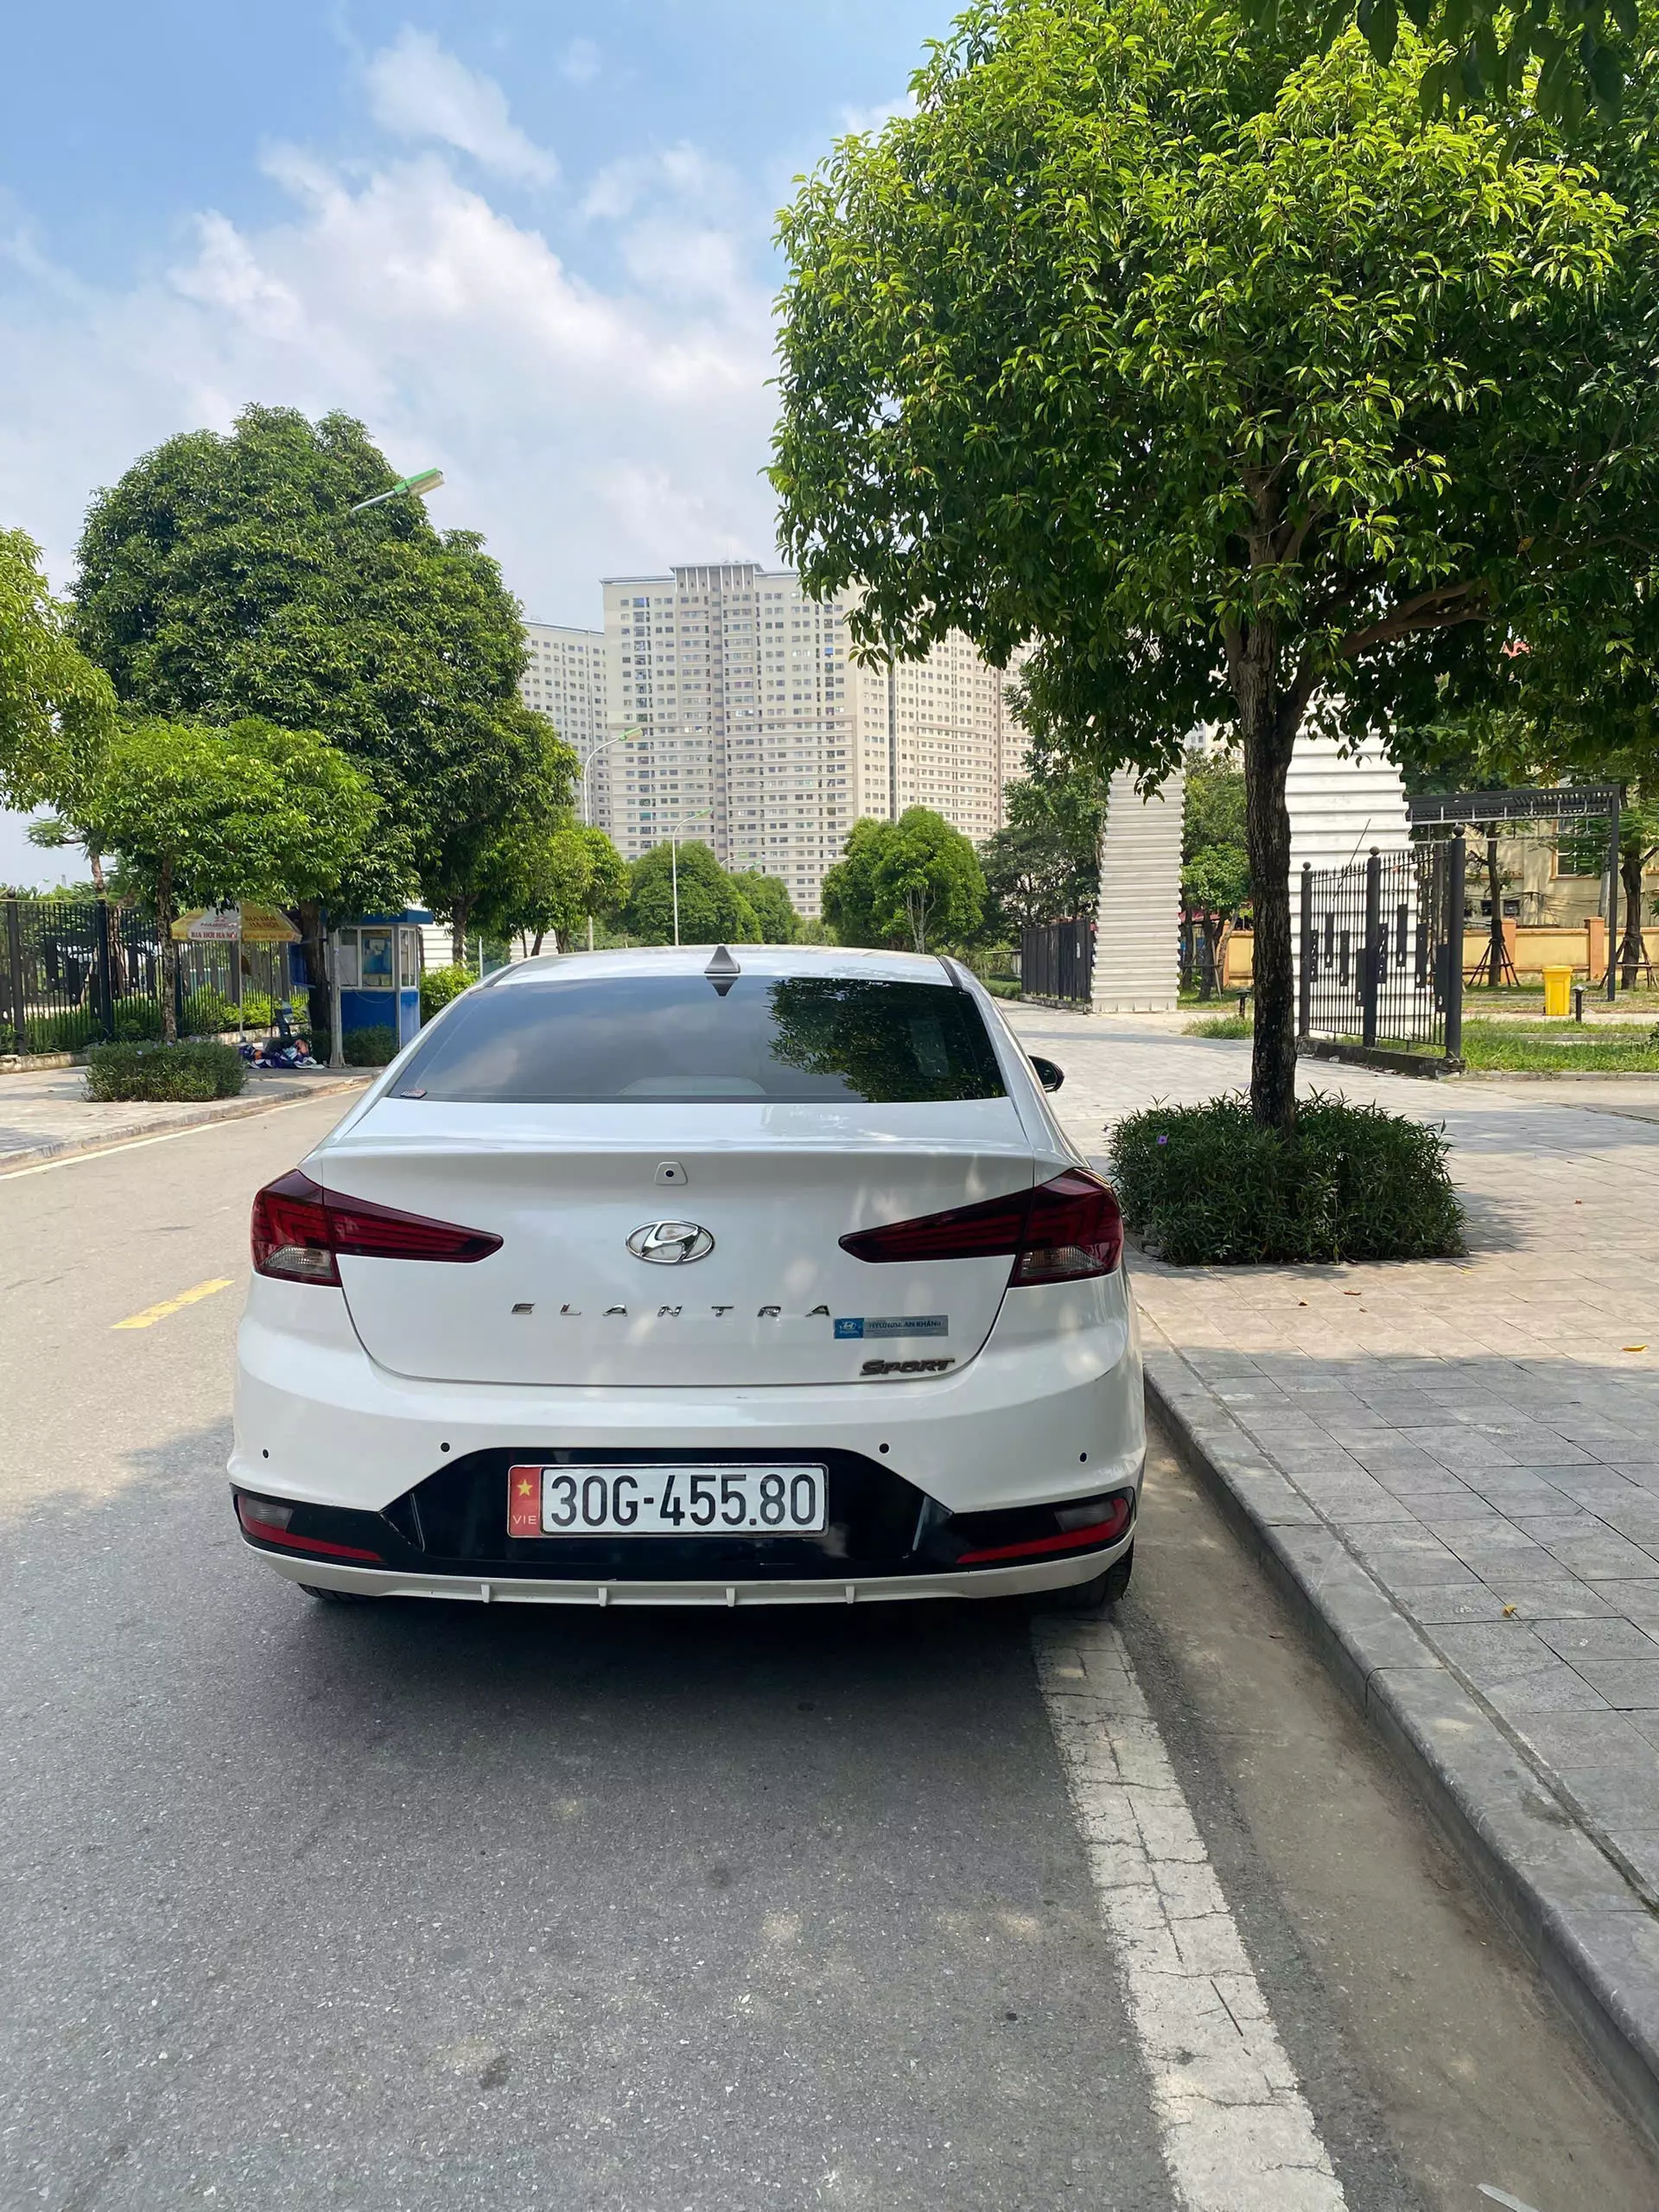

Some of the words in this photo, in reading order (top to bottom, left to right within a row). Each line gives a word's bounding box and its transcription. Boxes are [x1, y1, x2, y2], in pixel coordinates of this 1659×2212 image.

[512, 1303, 830, 1317] ELANTRA
[551, 1474, 817, 1527] 30G-455.80
[512, 1514, 537, 1525] VIE
